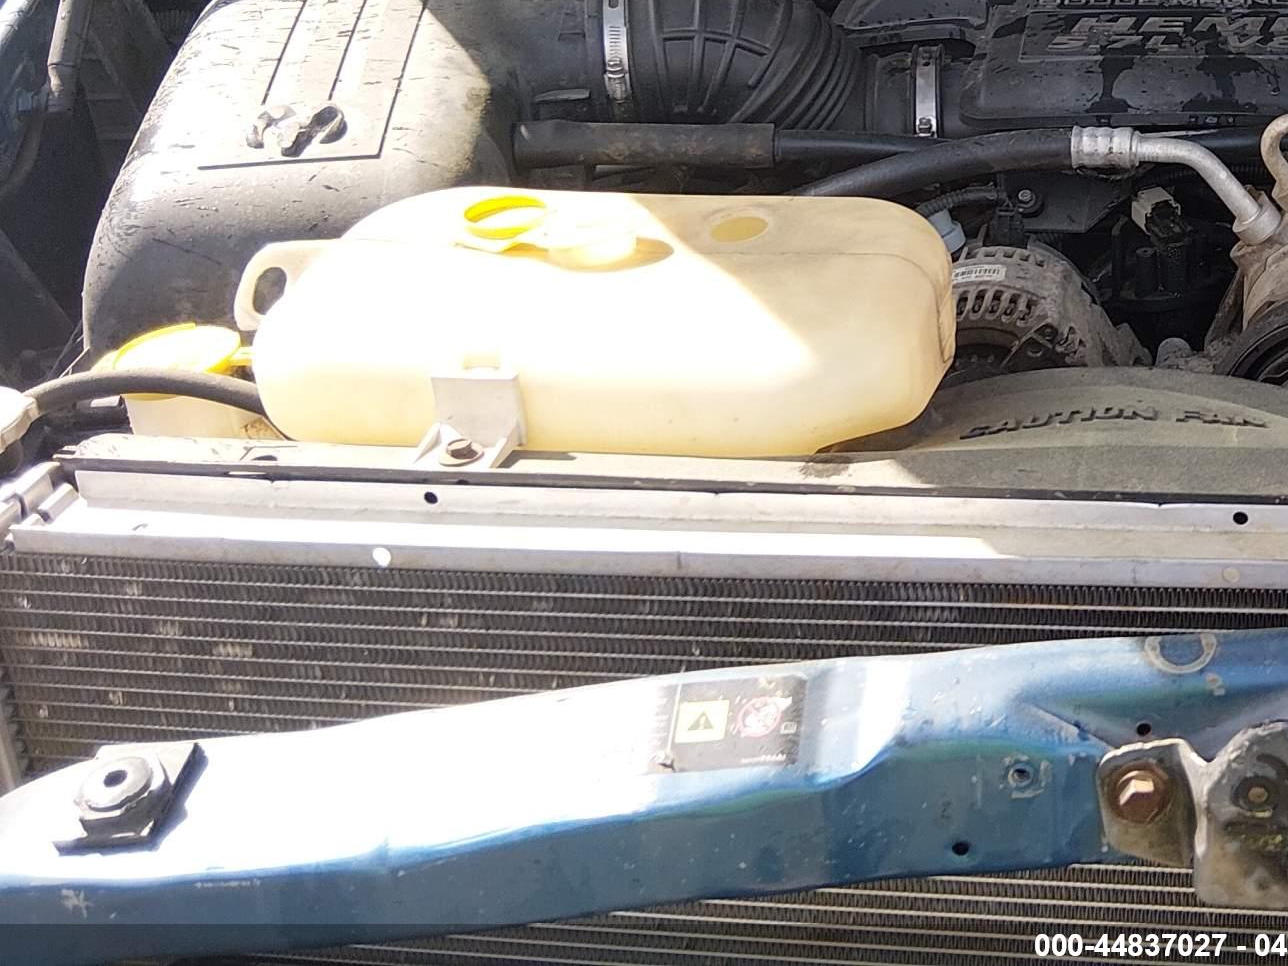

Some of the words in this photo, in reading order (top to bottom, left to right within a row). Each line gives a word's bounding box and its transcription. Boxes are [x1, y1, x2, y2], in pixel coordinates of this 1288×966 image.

[1047, 34, 1180, 51] 5.7L
[958, 406, 1160, 440] CAUTION
[1174, 409, 1268, 429] FAN
